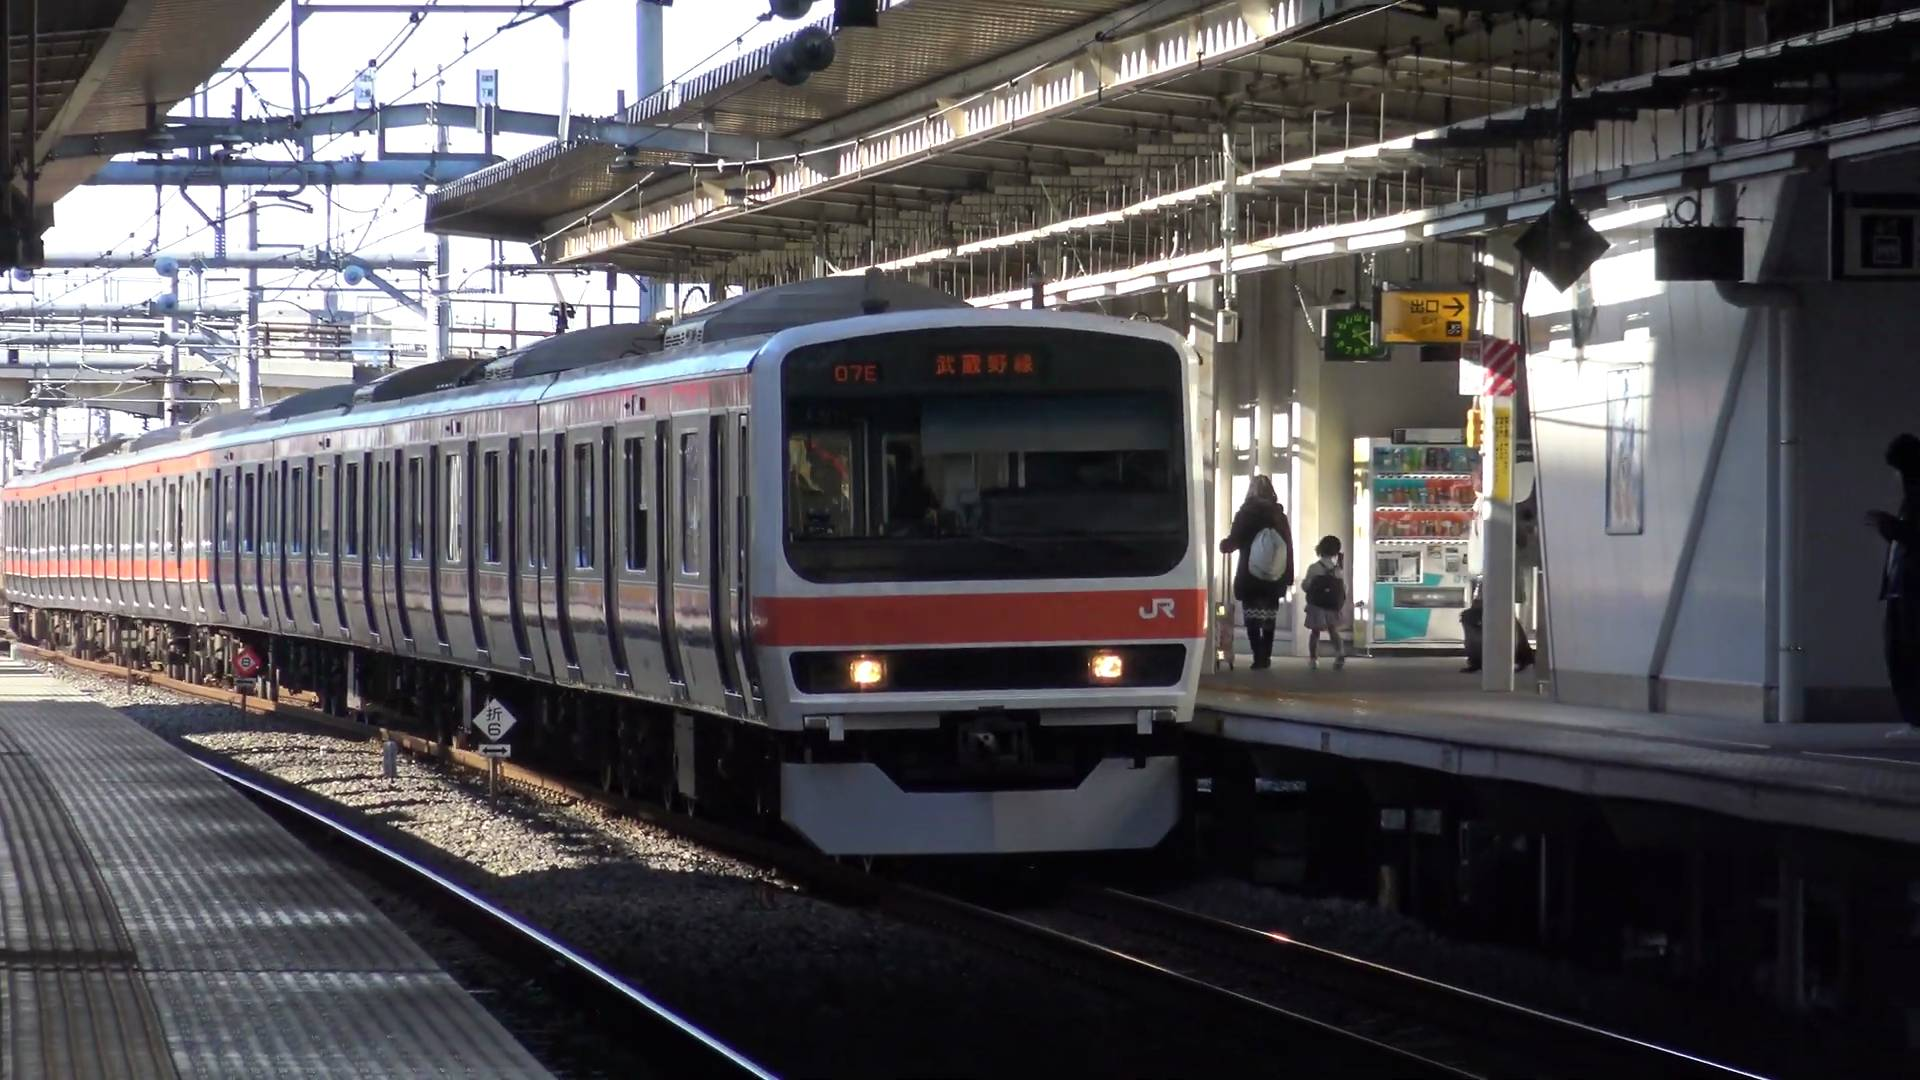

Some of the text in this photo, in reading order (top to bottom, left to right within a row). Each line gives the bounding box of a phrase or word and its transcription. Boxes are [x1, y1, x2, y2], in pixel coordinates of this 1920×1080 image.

[1410, 299, 1439, 313] 出口
[935, 353, 1034, 375] 武蔵野線
[834, 365, 878, 382] 07E
[1138, 598, 1176, 619] JR
[485, 706, 503, 721] 折
[487, 722, 502, 736] 6
